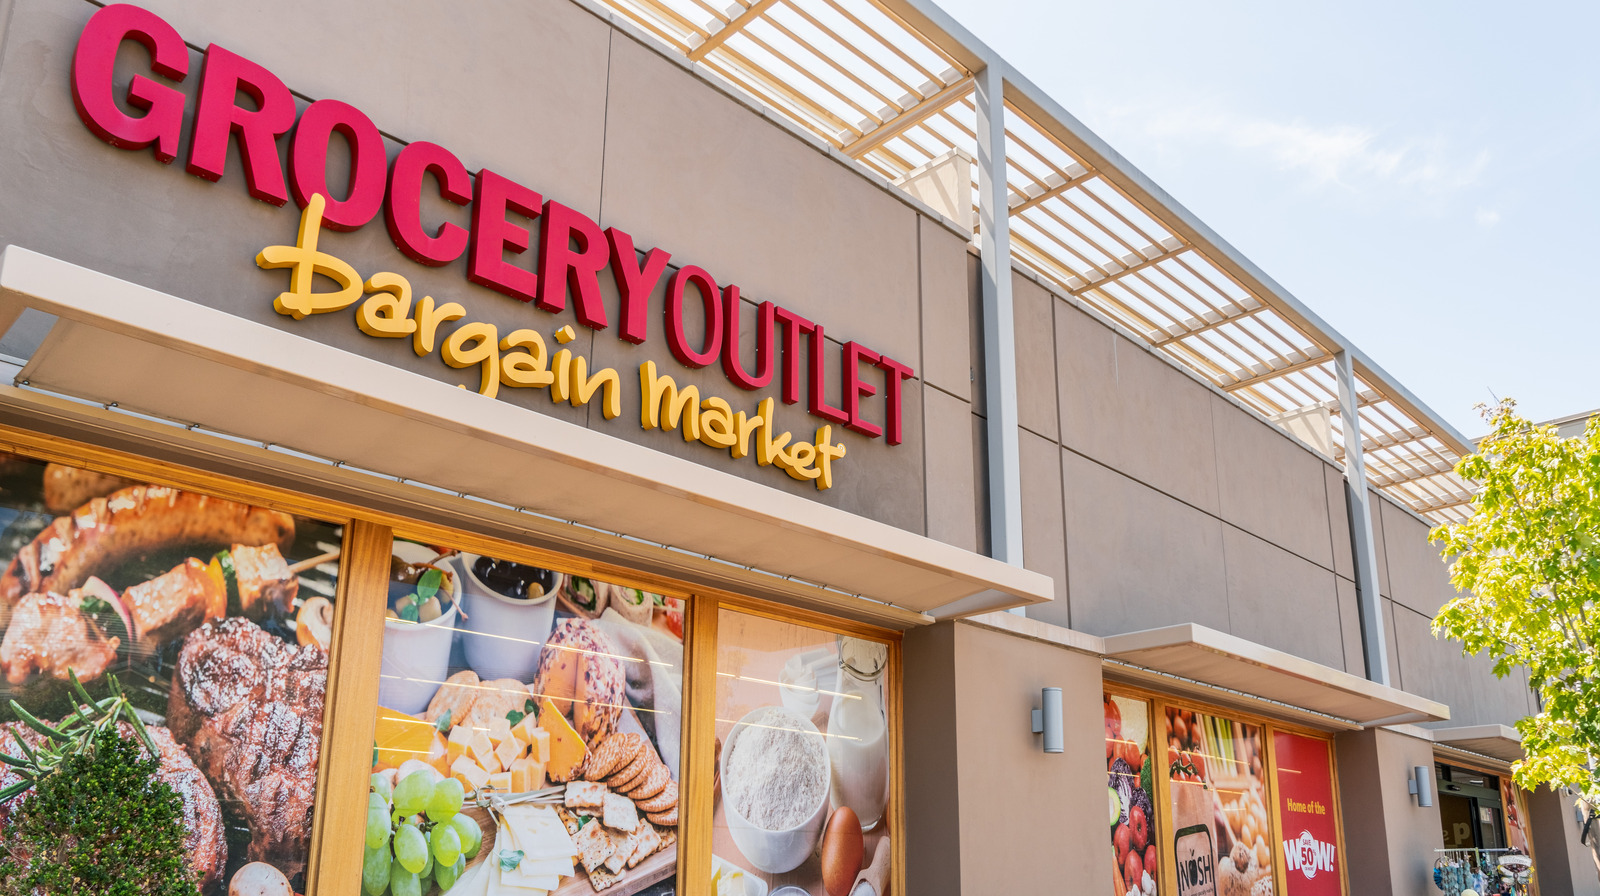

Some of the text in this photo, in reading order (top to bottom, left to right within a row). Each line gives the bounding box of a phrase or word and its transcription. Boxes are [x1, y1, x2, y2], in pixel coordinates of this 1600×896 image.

[71, 3, 915, 446] GROCERY OUTLET
[256, 192, 621, 421] bargain
[1180, 854, 1212, 891] NOSH
[1287, 798, 1326, 815] Home of the
